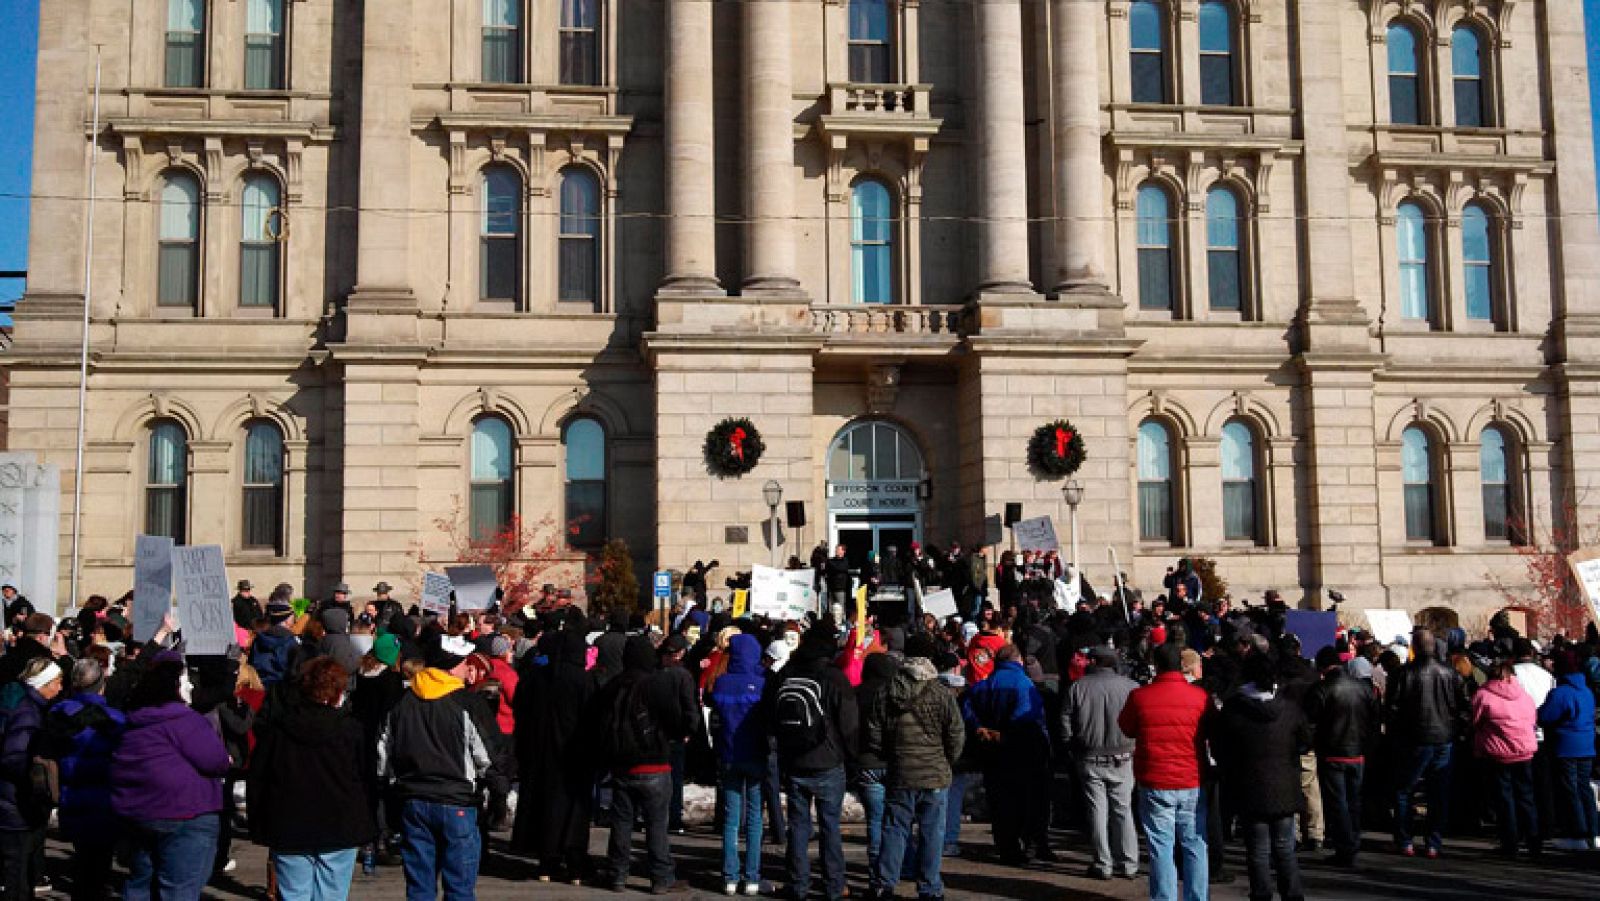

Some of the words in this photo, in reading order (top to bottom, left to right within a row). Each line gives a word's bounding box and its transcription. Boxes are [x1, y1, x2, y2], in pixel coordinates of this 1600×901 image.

[843, 498, 873, 507] COURT
[879, 498, 906, 507] HOUSE
[200, 575, 223, 595] NOT
